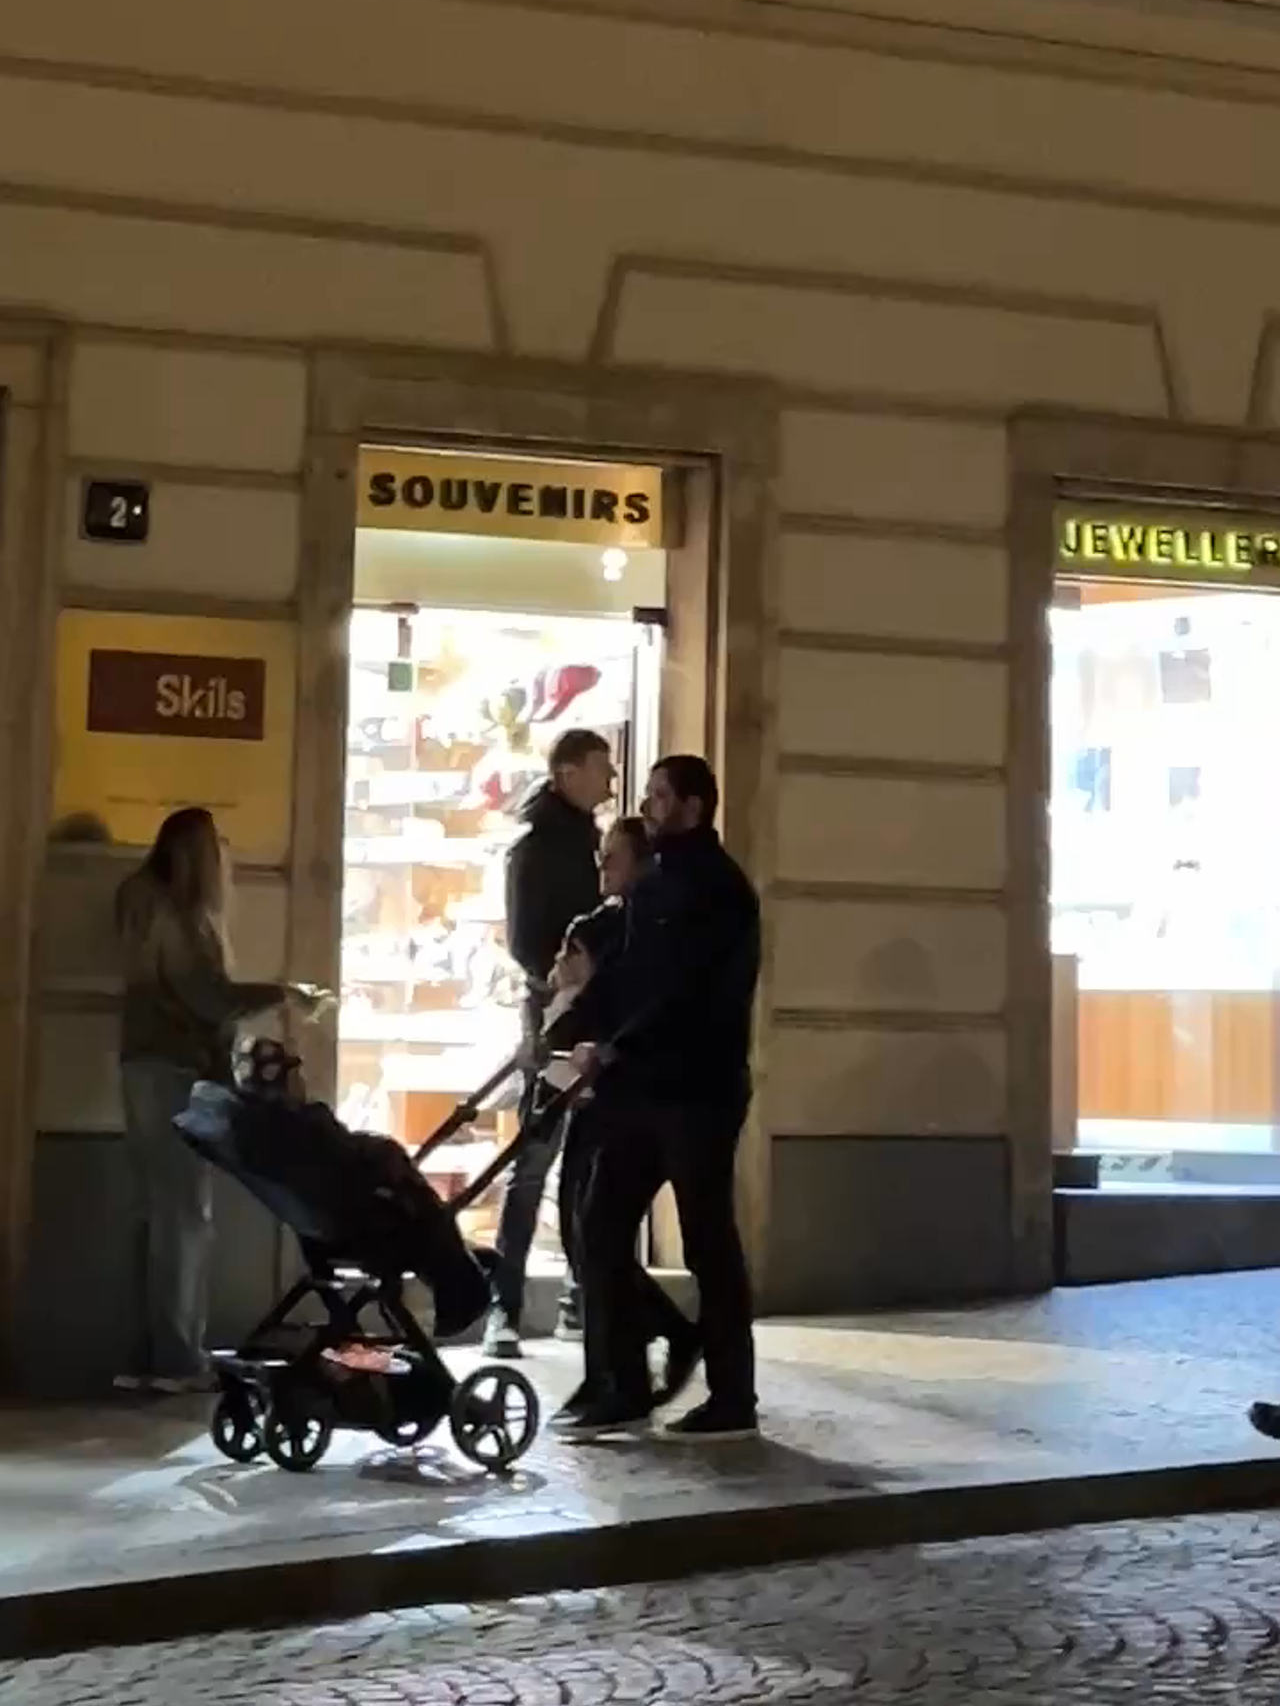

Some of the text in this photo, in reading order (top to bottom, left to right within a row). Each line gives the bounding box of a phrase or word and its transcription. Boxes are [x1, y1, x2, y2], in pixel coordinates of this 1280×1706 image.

[110, 496, 128, 528] 2
[367, 472, 651, 524] SOUVENIRS
[156, 674, 246, 720] Skils
